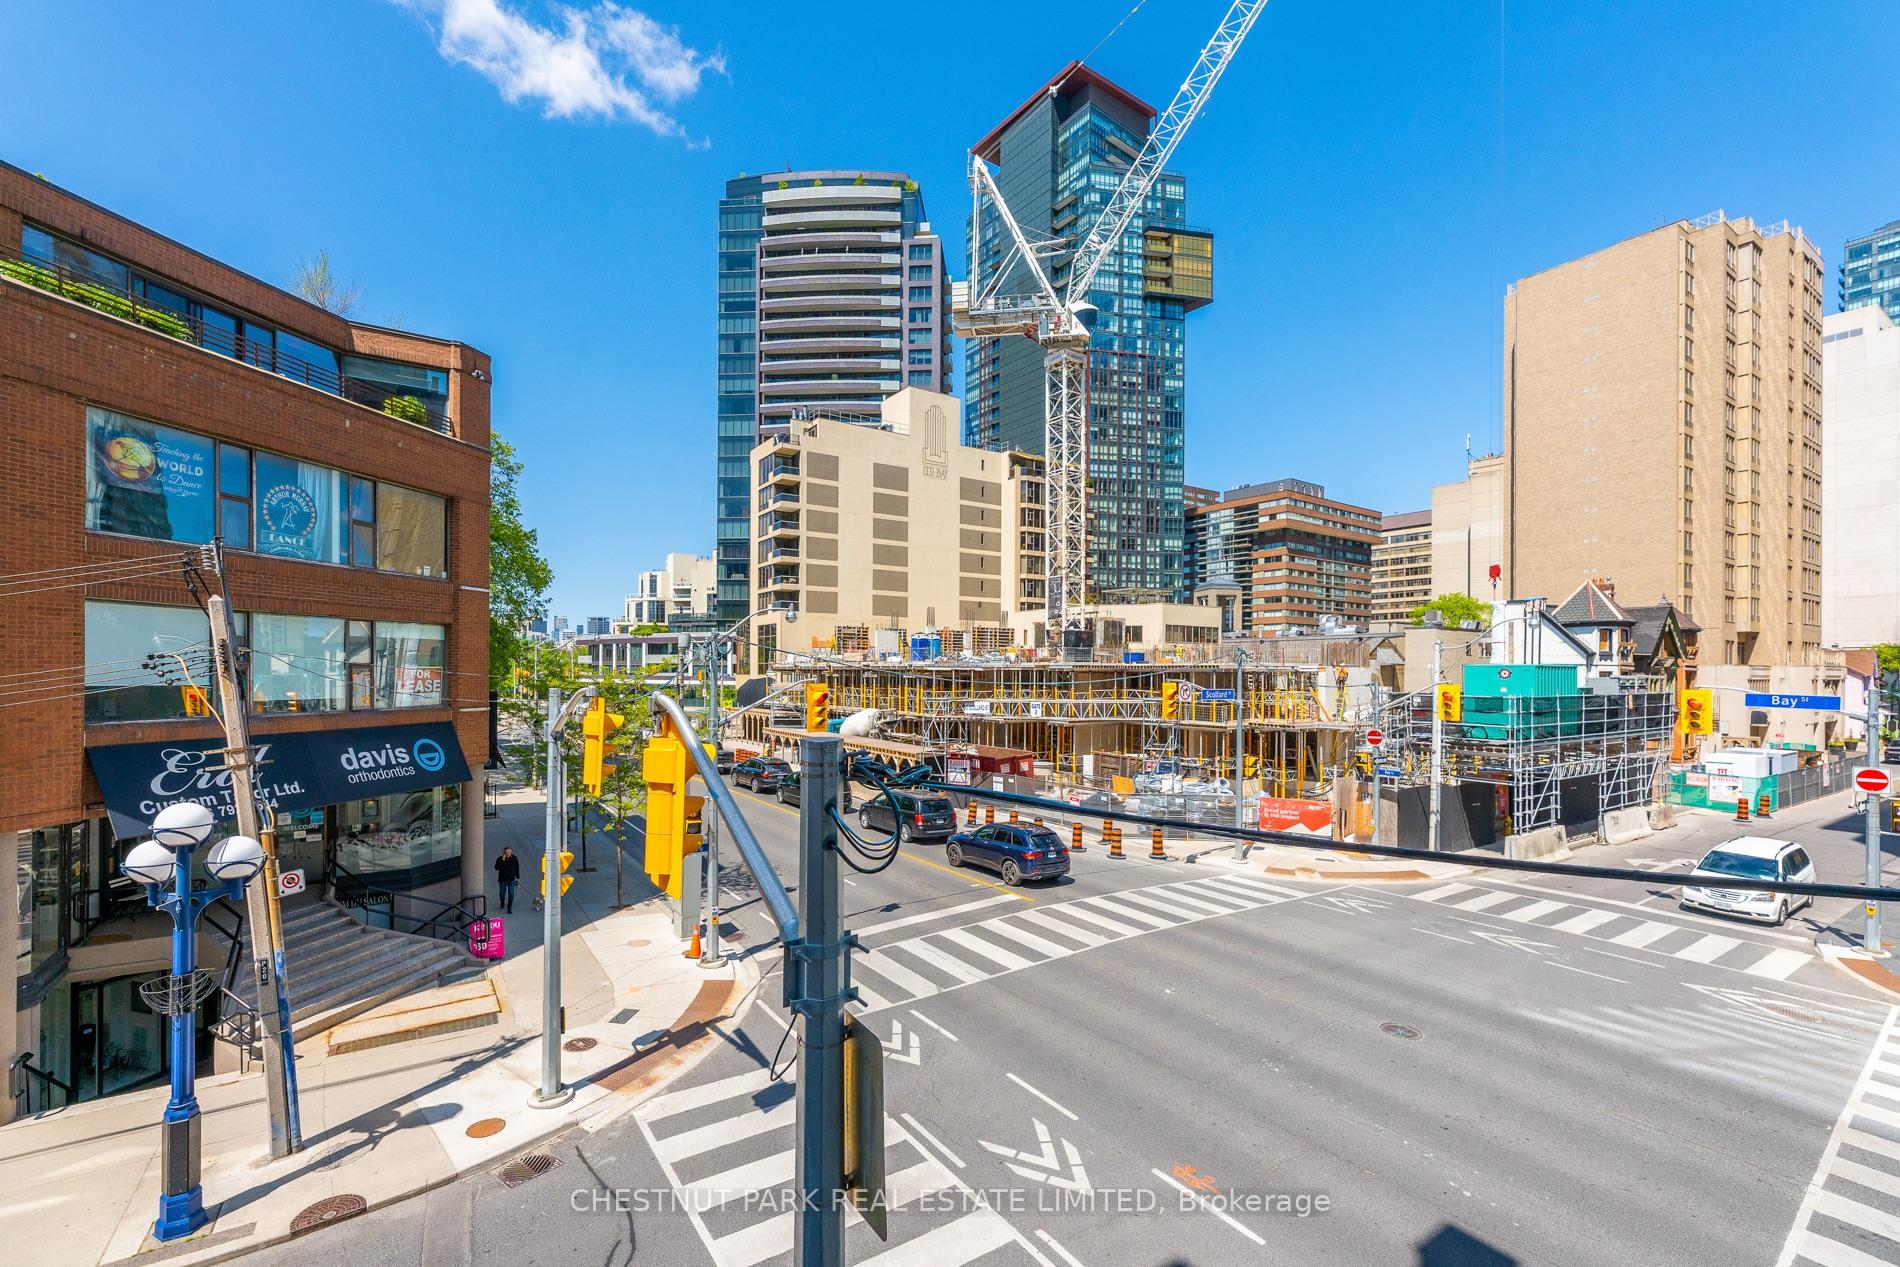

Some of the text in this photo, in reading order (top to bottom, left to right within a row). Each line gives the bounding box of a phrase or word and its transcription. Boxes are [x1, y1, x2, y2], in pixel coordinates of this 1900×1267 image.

[150, 441, 190, 462] Teaching
[157, 457, 204, 477] WORLD
[156, 472, 202, 489] to Dance
[269, 490, 290, 506] ARTHUR
[269, 533, 306, 547] DANCE
[410, 668, 431, 679] FOR
[397, 680, 441, 693] LEASE
[1205, 690, 1228, 699] Scollard
[1771, 695, 1798, 708] Bay
[340, 743, 410, 771] davis
[348, 760, 416, 784] orthodontics
[273, 781, 305, 796] Ltd.
[283, 823, 320, 831] WELCOME
